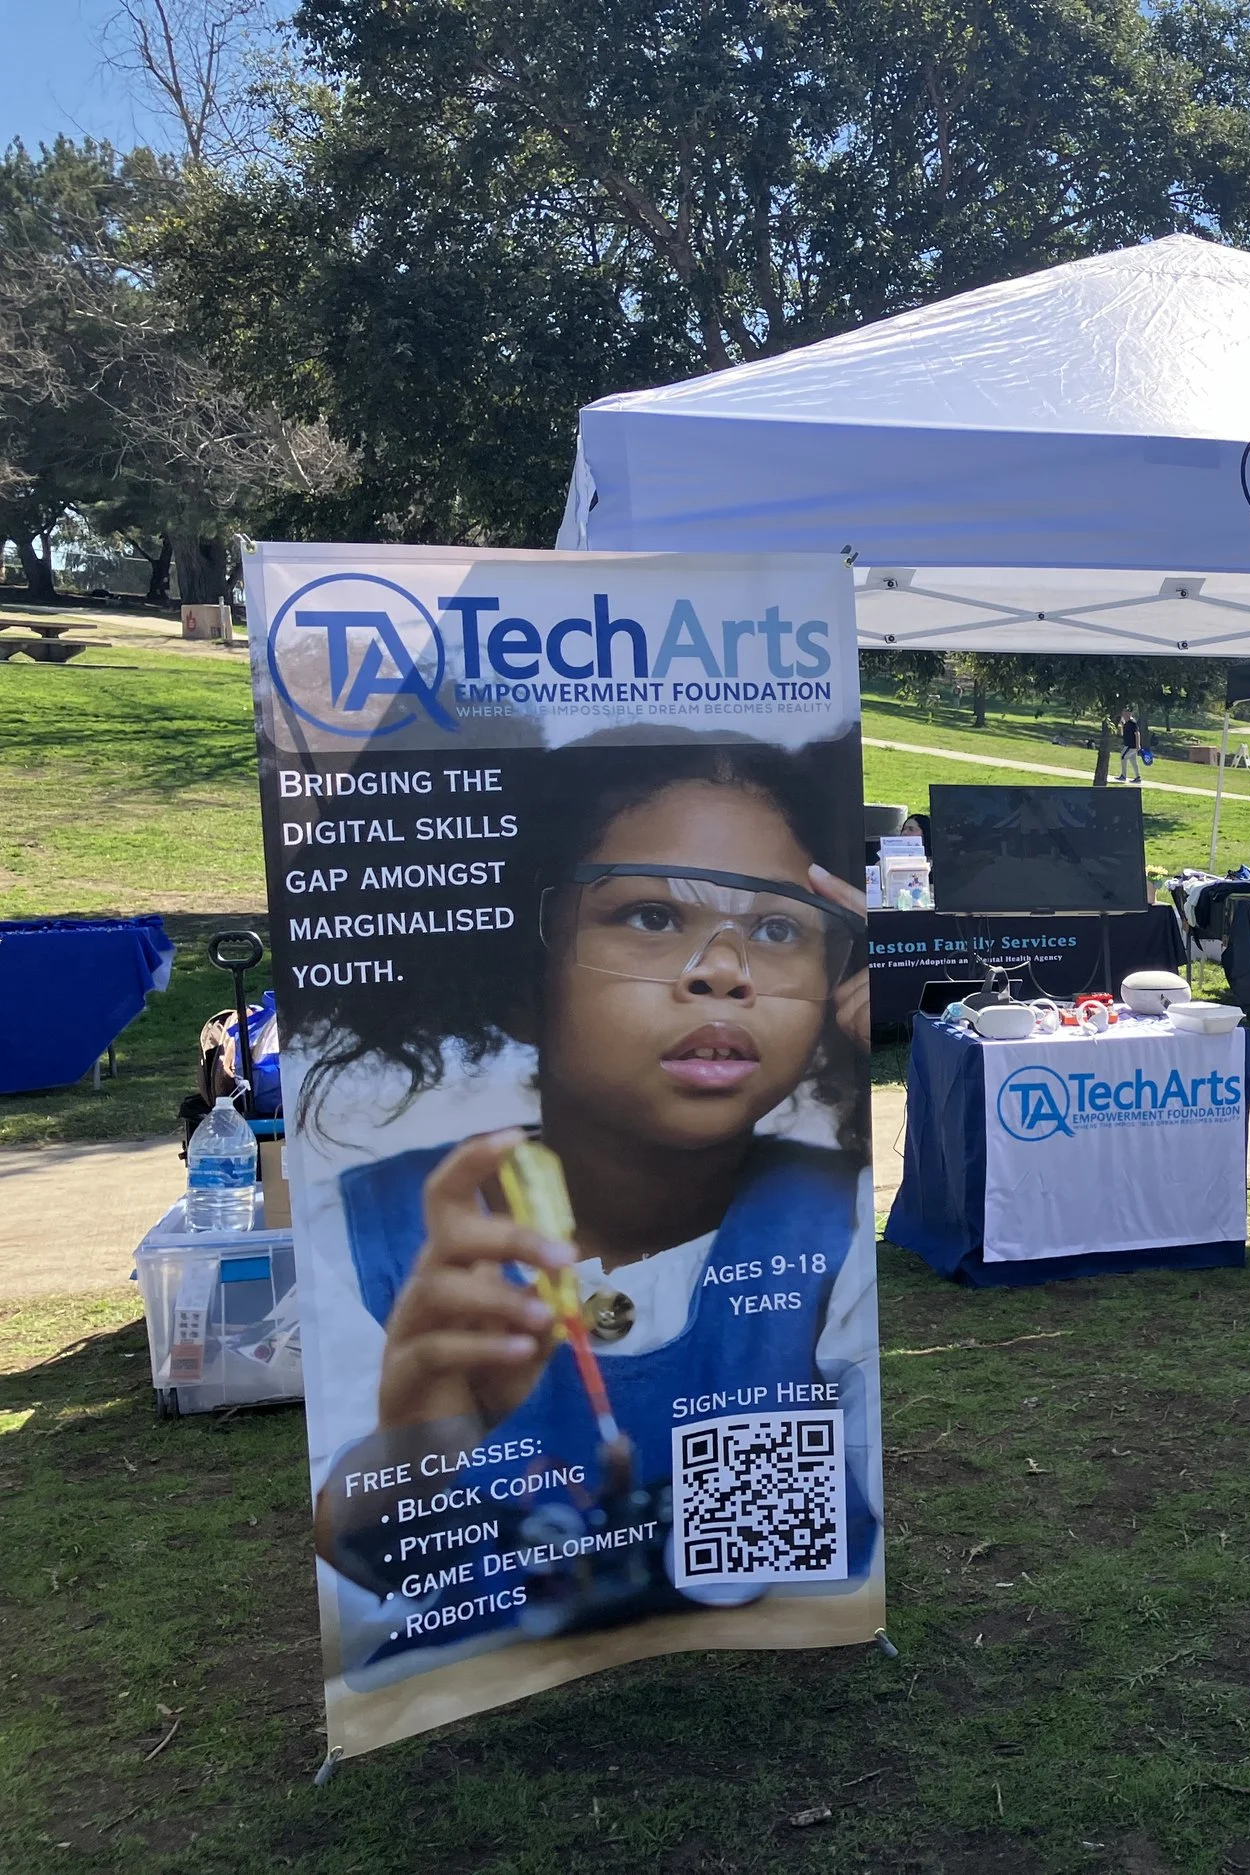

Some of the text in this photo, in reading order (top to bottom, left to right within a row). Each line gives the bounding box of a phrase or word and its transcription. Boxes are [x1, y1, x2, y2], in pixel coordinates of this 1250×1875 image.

[437, 593, 832, 681] TechArts
[455, 682, 831, 703] EMPOWERMENT FOUNDATION
[456, 706, 513, 718] WHERE
[553, 704, 644, 716] IMPOSSIBLE
[648, 703, 700, 715] DREAM
[705, 703, 773, 714] BECOMES
[778, 702, 832, 713] REALITY
[279, 769, 503, 797] BRIDGING THE
[283, 815, 518, 846] DIGITAL SKILLS
[285, 861, 505, 893] GAP AMONGST
[289, 907, 515, 941] MARGINALISED
[869, 941, 927, 955] leston
[1001, 935, 1077, 949] Services
[869, 961, 886, 969] ster
[888, 958, 957, 968] Family/Adoption
[1005, 955, 1032, 963] Health
[1034, 954, 1063, 963] Agency
[292, 960, 404, 989] YOUTH.
[1068, 1068, 1242, 1112] TechArts
[1072, 1106, 1240, 1124] EMPOWERMENT FOUNDATION
[703, 1253, 827, 1287] AGES 9-18
[729, 1292, 802, 1316] YEARS
[672, 1381, 839, 1418] SIGN-UP HERE
[345, 1438, 543, 1497] FREE CLASSES:
[398, 1465, 586, 1523] BLOCK CODING
[400, 1520, 500, 1561] PYTHON
[401, 1521, 658, 1598] GAME DEVELOPMENT
[405, 1586, 528, 1639] ROBOTICS
